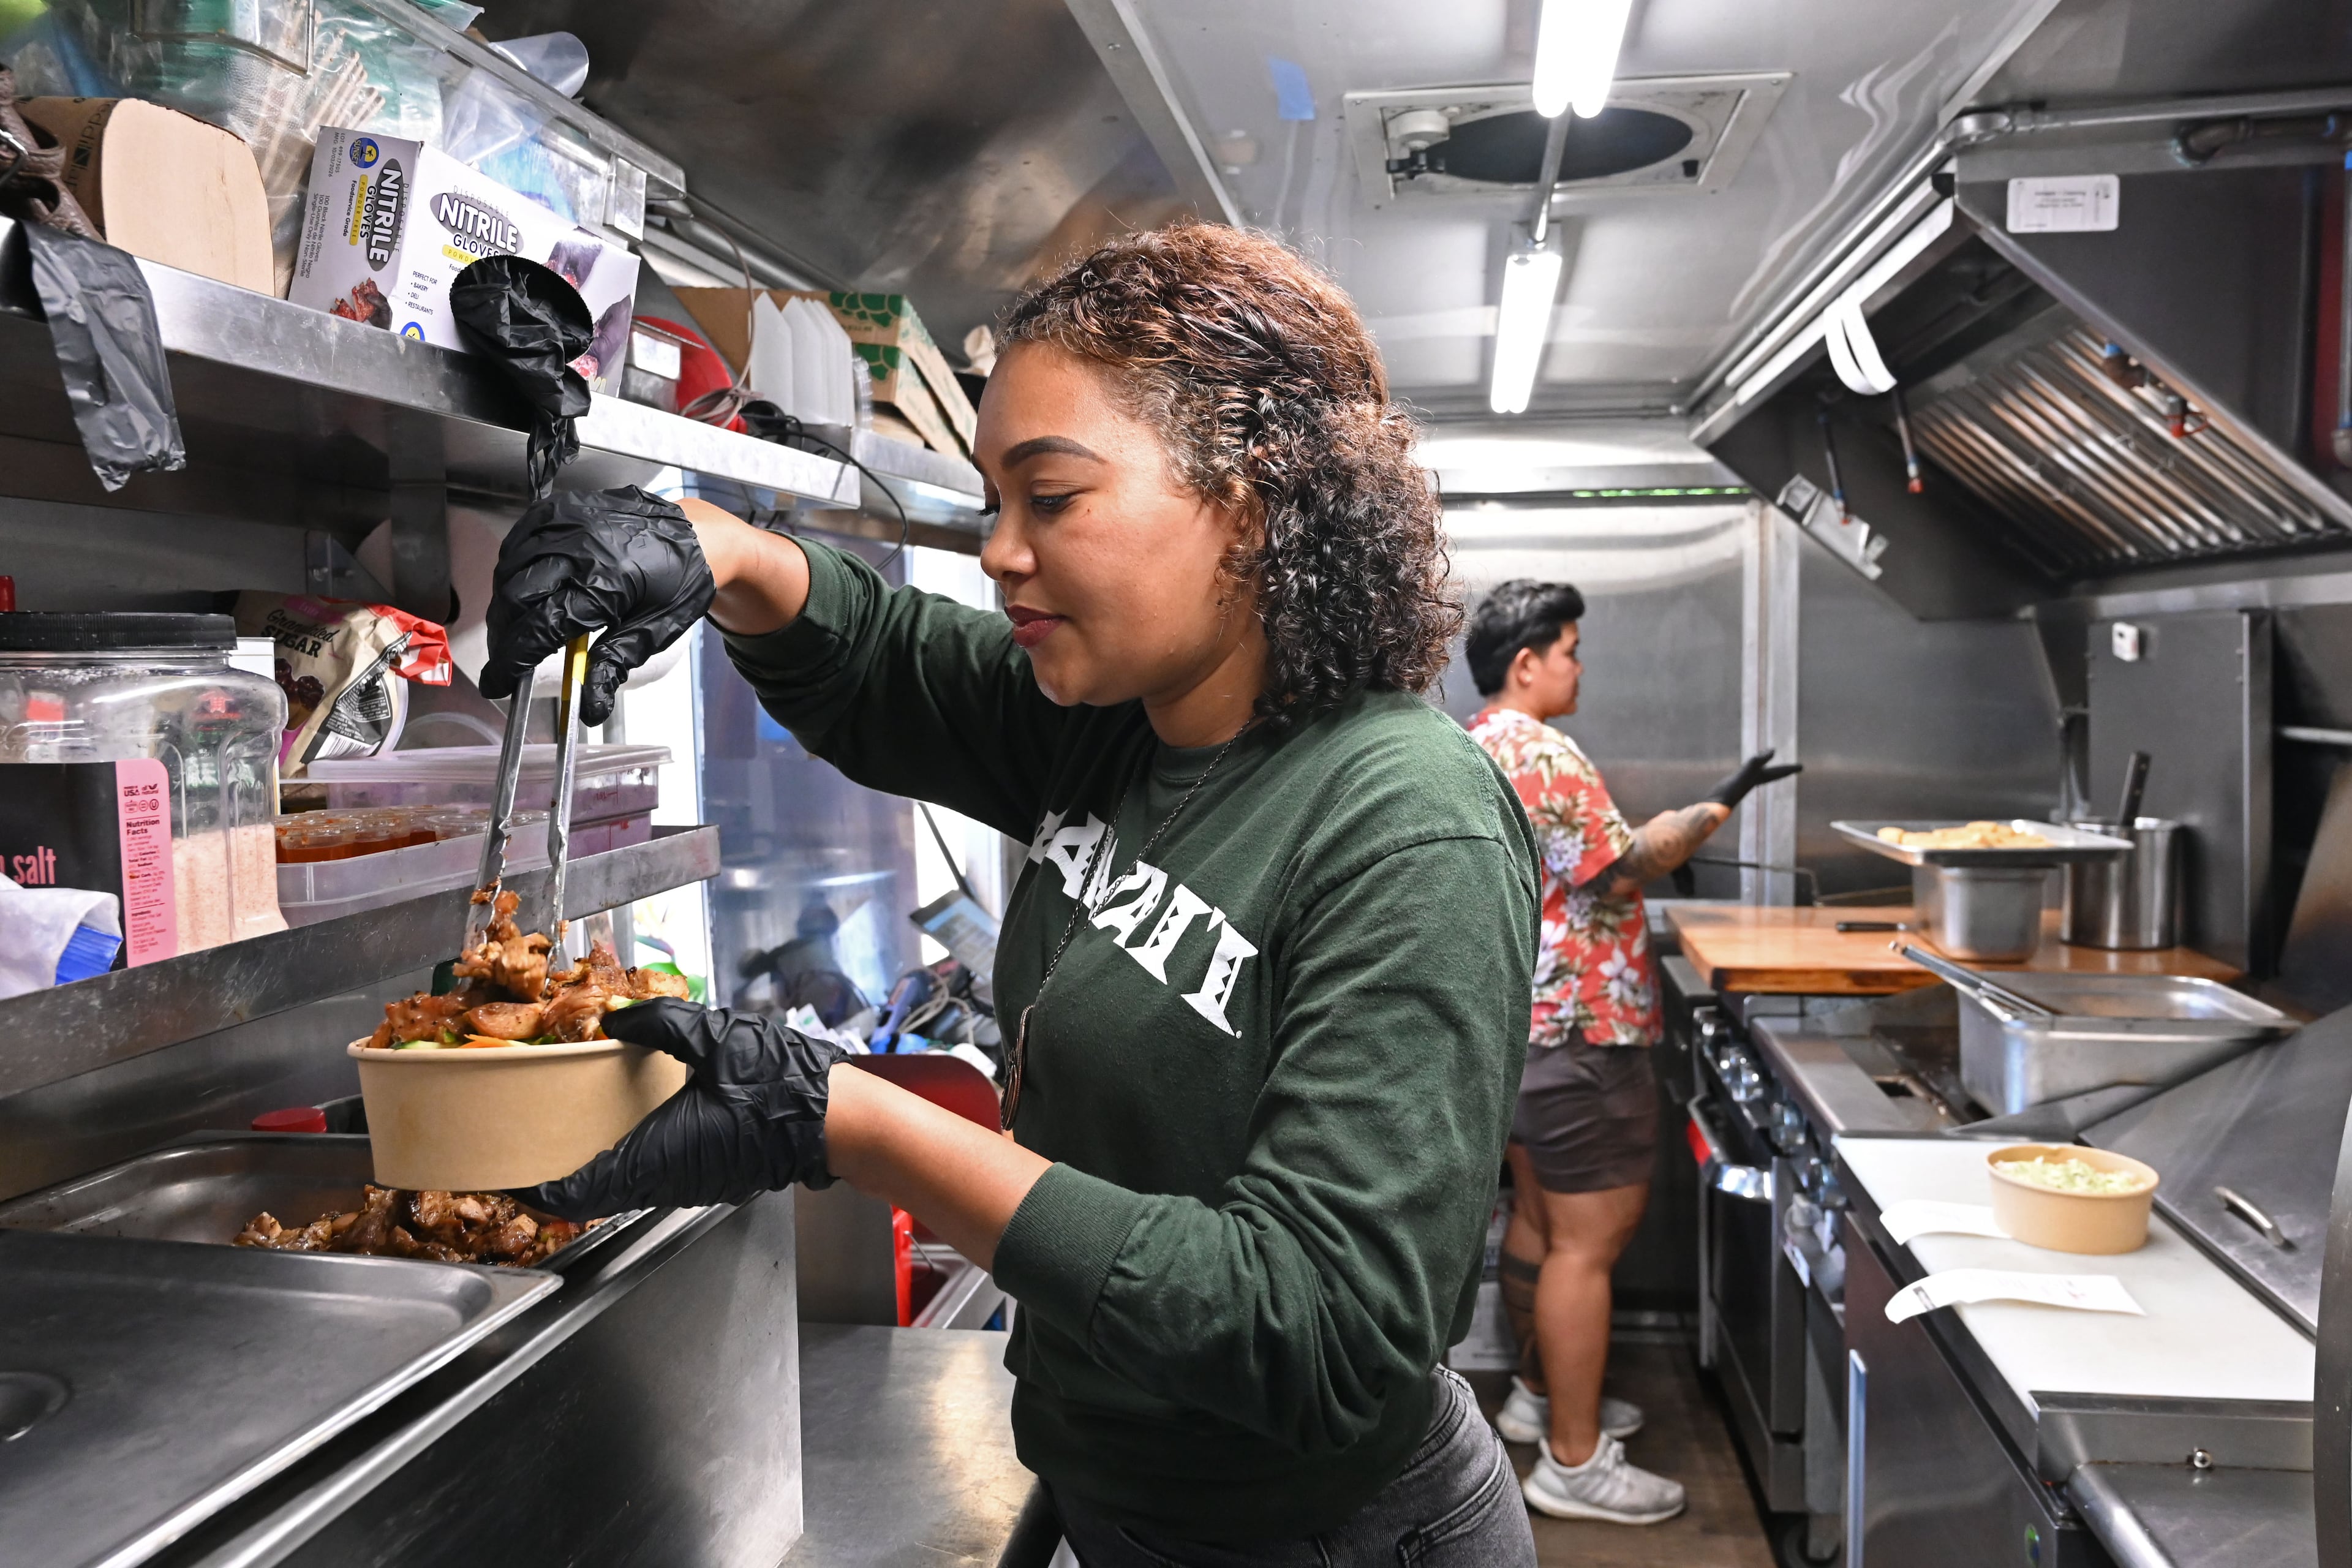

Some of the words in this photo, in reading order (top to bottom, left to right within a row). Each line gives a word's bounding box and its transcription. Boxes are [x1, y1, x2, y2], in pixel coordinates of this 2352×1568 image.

[328, 147, 337, 177] 10/03/2026
[352, 140, 361, 165] SUNSET
[309, 193, 318, 225] Single-Use
[346, 180, 357, 216] Foodservice
[356, 181, 366, 215] POWDER
[360, 186, 377, 239] GLOVES
[453, 185, 509, 219] DISPOSABLE
[313, 206, 322, 231] Guantes
[342, 217, 351, 237] Grade
[369, 168, 402, 263] NITRILE
[393, 184, 409, 252] DISPOSABLE
[439, 193, 518, 254] NITRILE
[305, 226, 314, 240] Only
[300, 244, 311, 277] Non-Sterile
[304, 260, 313, 278] Negro
[448, 249, 473, 263] POWDE
[413, 271, 429, 282] PERFECT
[413, 282, 429, 292] BAKERY
[408, 301, 433, 315] RESTAURANTS
[260, 625, 322, 658] SUGAR
[126, 819, 160, 828] Nutrition
[13, 845, 57, 884] salt
